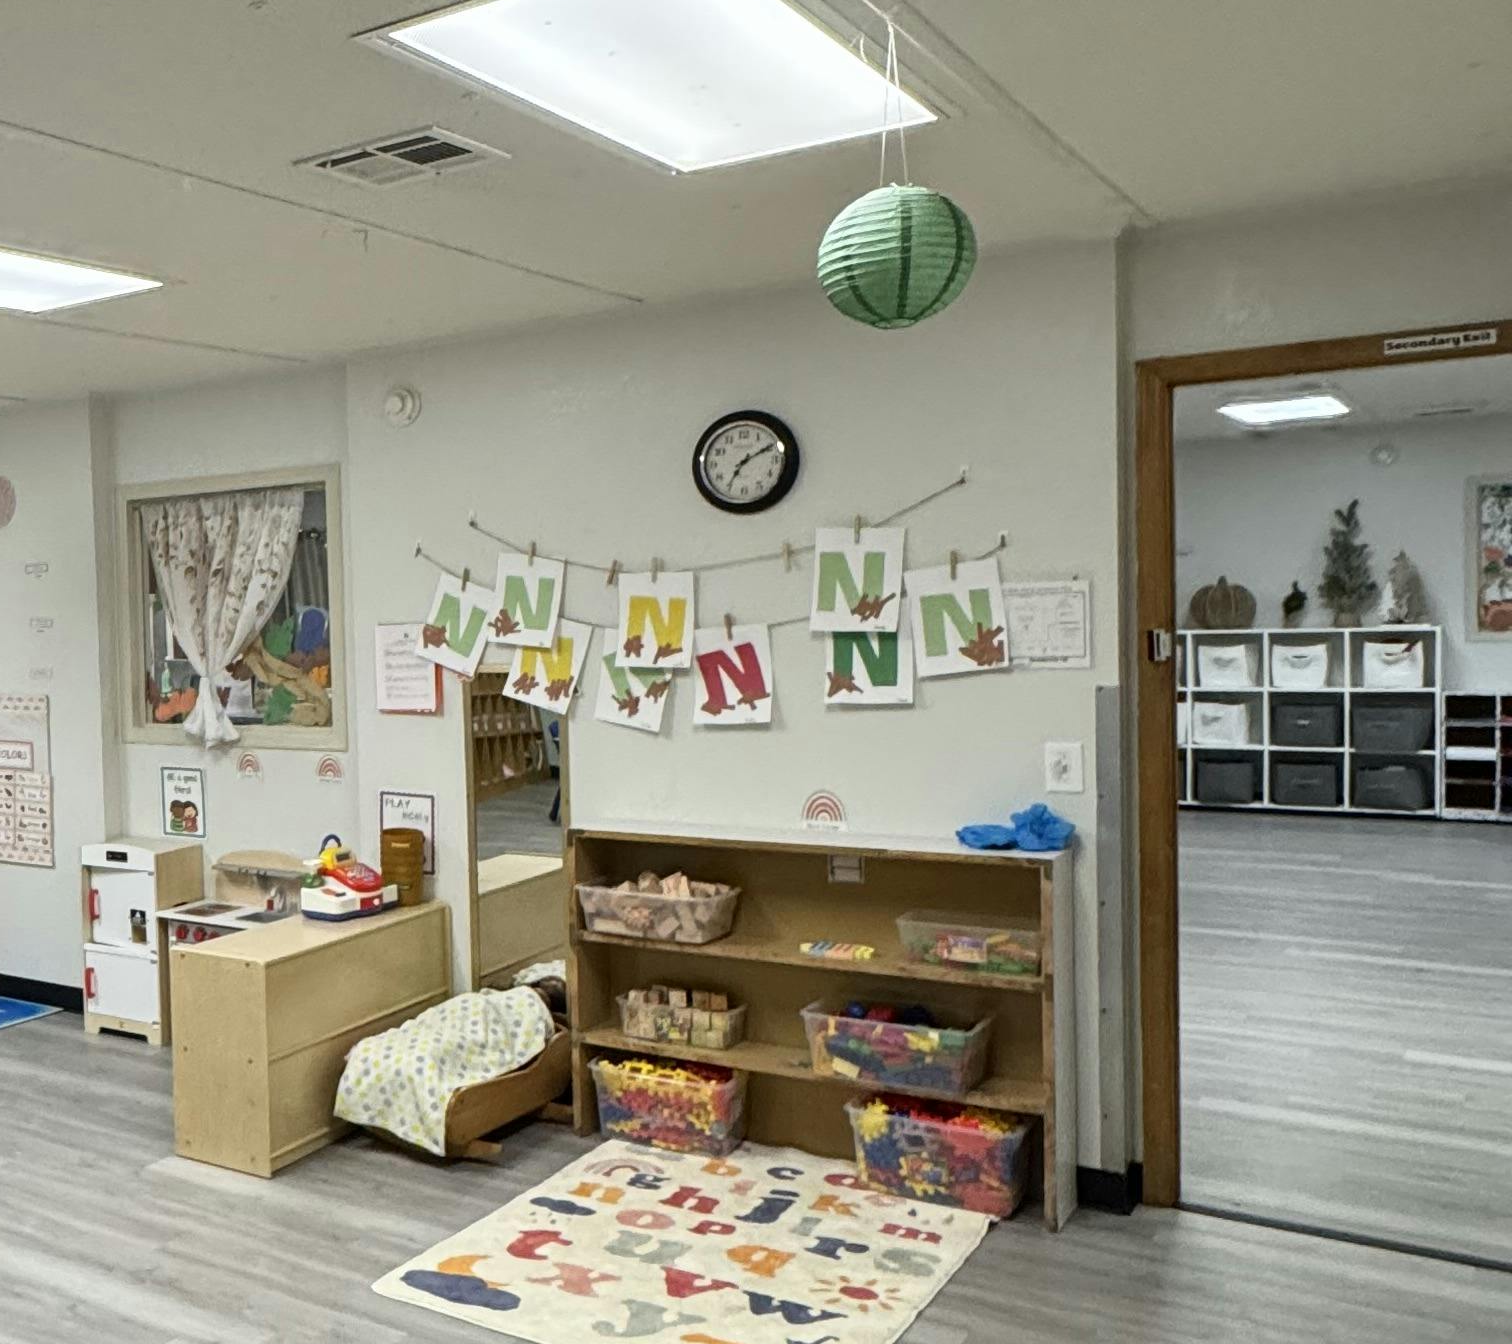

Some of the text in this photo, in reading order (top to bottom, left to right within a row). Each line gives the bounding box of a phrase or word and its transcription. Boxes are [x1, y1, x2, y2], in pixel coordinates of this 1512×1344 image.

[1386, 332, 1491, 350] Secondary Exit
[503, 576, 556, 631] N
[817, 552, 886, 612] N
[432, 593, 487, 658] N
[627, 595, 687, 654] N
[920, 588, 992, 657] N
[697, 642, 767, 709] N
[832, 632, 898, 687] N
[385, 798, 411, 808] PLAY
[568, 1182, 625, 1205] n
[616, 1209, 676, 1230] o
[687, 1220, 736, 1235] p
[878, 1223, 943, 1244] m
[659, 1186, 721, 1214] h
